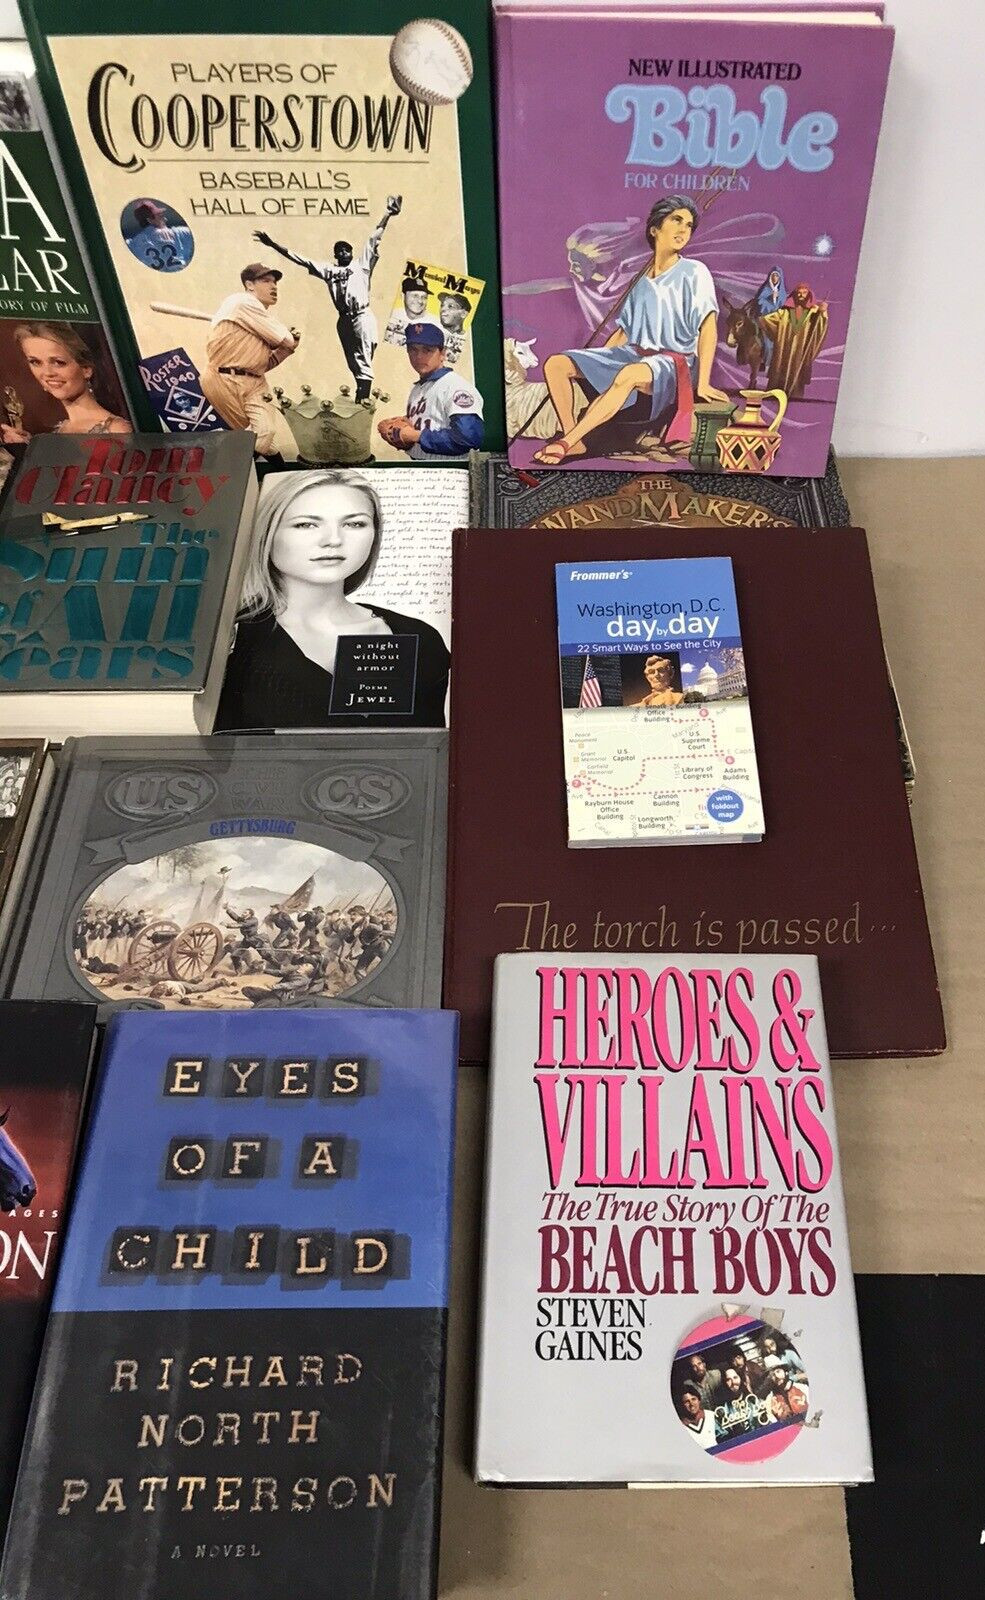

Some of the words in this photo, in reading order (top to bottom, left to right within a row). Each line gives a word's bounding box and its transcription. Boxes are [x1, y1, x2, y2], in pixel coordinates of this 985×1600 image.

[172, 63, 294, 83] PLAYERS
[300, 64, 337, 82] OF
[627, 58, 673, 78] NEW
[677, 60, 802, 81] ILLUSTRATED
[87, 62, 434, 173] COOPERSTOWN
[605, 83, 839, 172] Bible
[200, 169, 351, 191] BASEBALL'S
[624, 173, 657, 189] FOR
[662, 174, 750, 192] CHILDREN
[191, 198, 256, 216] HALL
[261, 198, 297, 215] OF
[303, 198, 370, 216] FAME
[145, 244, 177, 271] 32
[31, 300, 49, 312] OF
[55, 302, 89, 315] FILM
[138, 355, 191, 392] ROSTER
[165, 371, 196, 387] 1940
[81, 439, 206, 476] Tom
[16, 465, 230, 517] Clancy
[636, 480, 672, 490] THE
[577, 601, 688, 620] Washington,
[691, 598, 726, 613] D.C.
[606, 615, 657, 641] day
[656, 627, 668, 636] by
[668, 612, 719, 638] day
[0, 631, 195, 681] ears
[367, 641, 399, 651] night
[577, 644, 590, 653] 22
[592, 643, 621, 653] Smart
[623, 642, 648, 654] Ways
[650, 642, 661, 650] to
[664, 641, 682, 650] See
[684, 640, 700, 649] the
[703, 639, 721, 650] City
[345, 693, 396, 706] JEWEL
[682, 767, 705, 775] Library
[120, 775, 201, 810] US
[316, 773, 396, 809] CS
[209, 819, 297, 837] GETTYSBURG
[597, 813, 624, 821] Building
[638, 815, 674, 823] Longworth
[638, 821, 666, 829] Building
[493, 899, 578, 952] The
[592, 905, 678, 948] torch
[692, 910, 723, 947] is
[533, 966, 761, 1073] HEROES
[769, 967, 822, 1074] &
[170, 1061, 359, 1094] EYES
[533, 1073, 834, 1193] VILLAINS
[172, 1141, 261, 1176] OF
[304, 1141, 337, 1176] A
[8, 1209, 58, 1218] AGES
[541, 1192, 589, 1222] The
[595, 1193, 657, 1222] True
[662, 1193, 736, 1231] Story
[741, 1194, 782, 1231] Of
[779, 1194, 830, 1222] The
[117, 1231, 389, 1275] CHILD
[537, 1225, 699, 1295] BEACH
[712, 1226, 836, 1297] BOYS
[536, 1298, 647, 1328] STEVEN
[534, 1331, 643, 1362] GAINES
[111, 1354, 363, 1392] RICHARD
[137, 1411, 321, 1448] NORTH
[57, 1473, 397, 1515] PATTERSON
[171, 1545, 182, 1559] A
[195, 1545, 263, 1559] NOVEL
